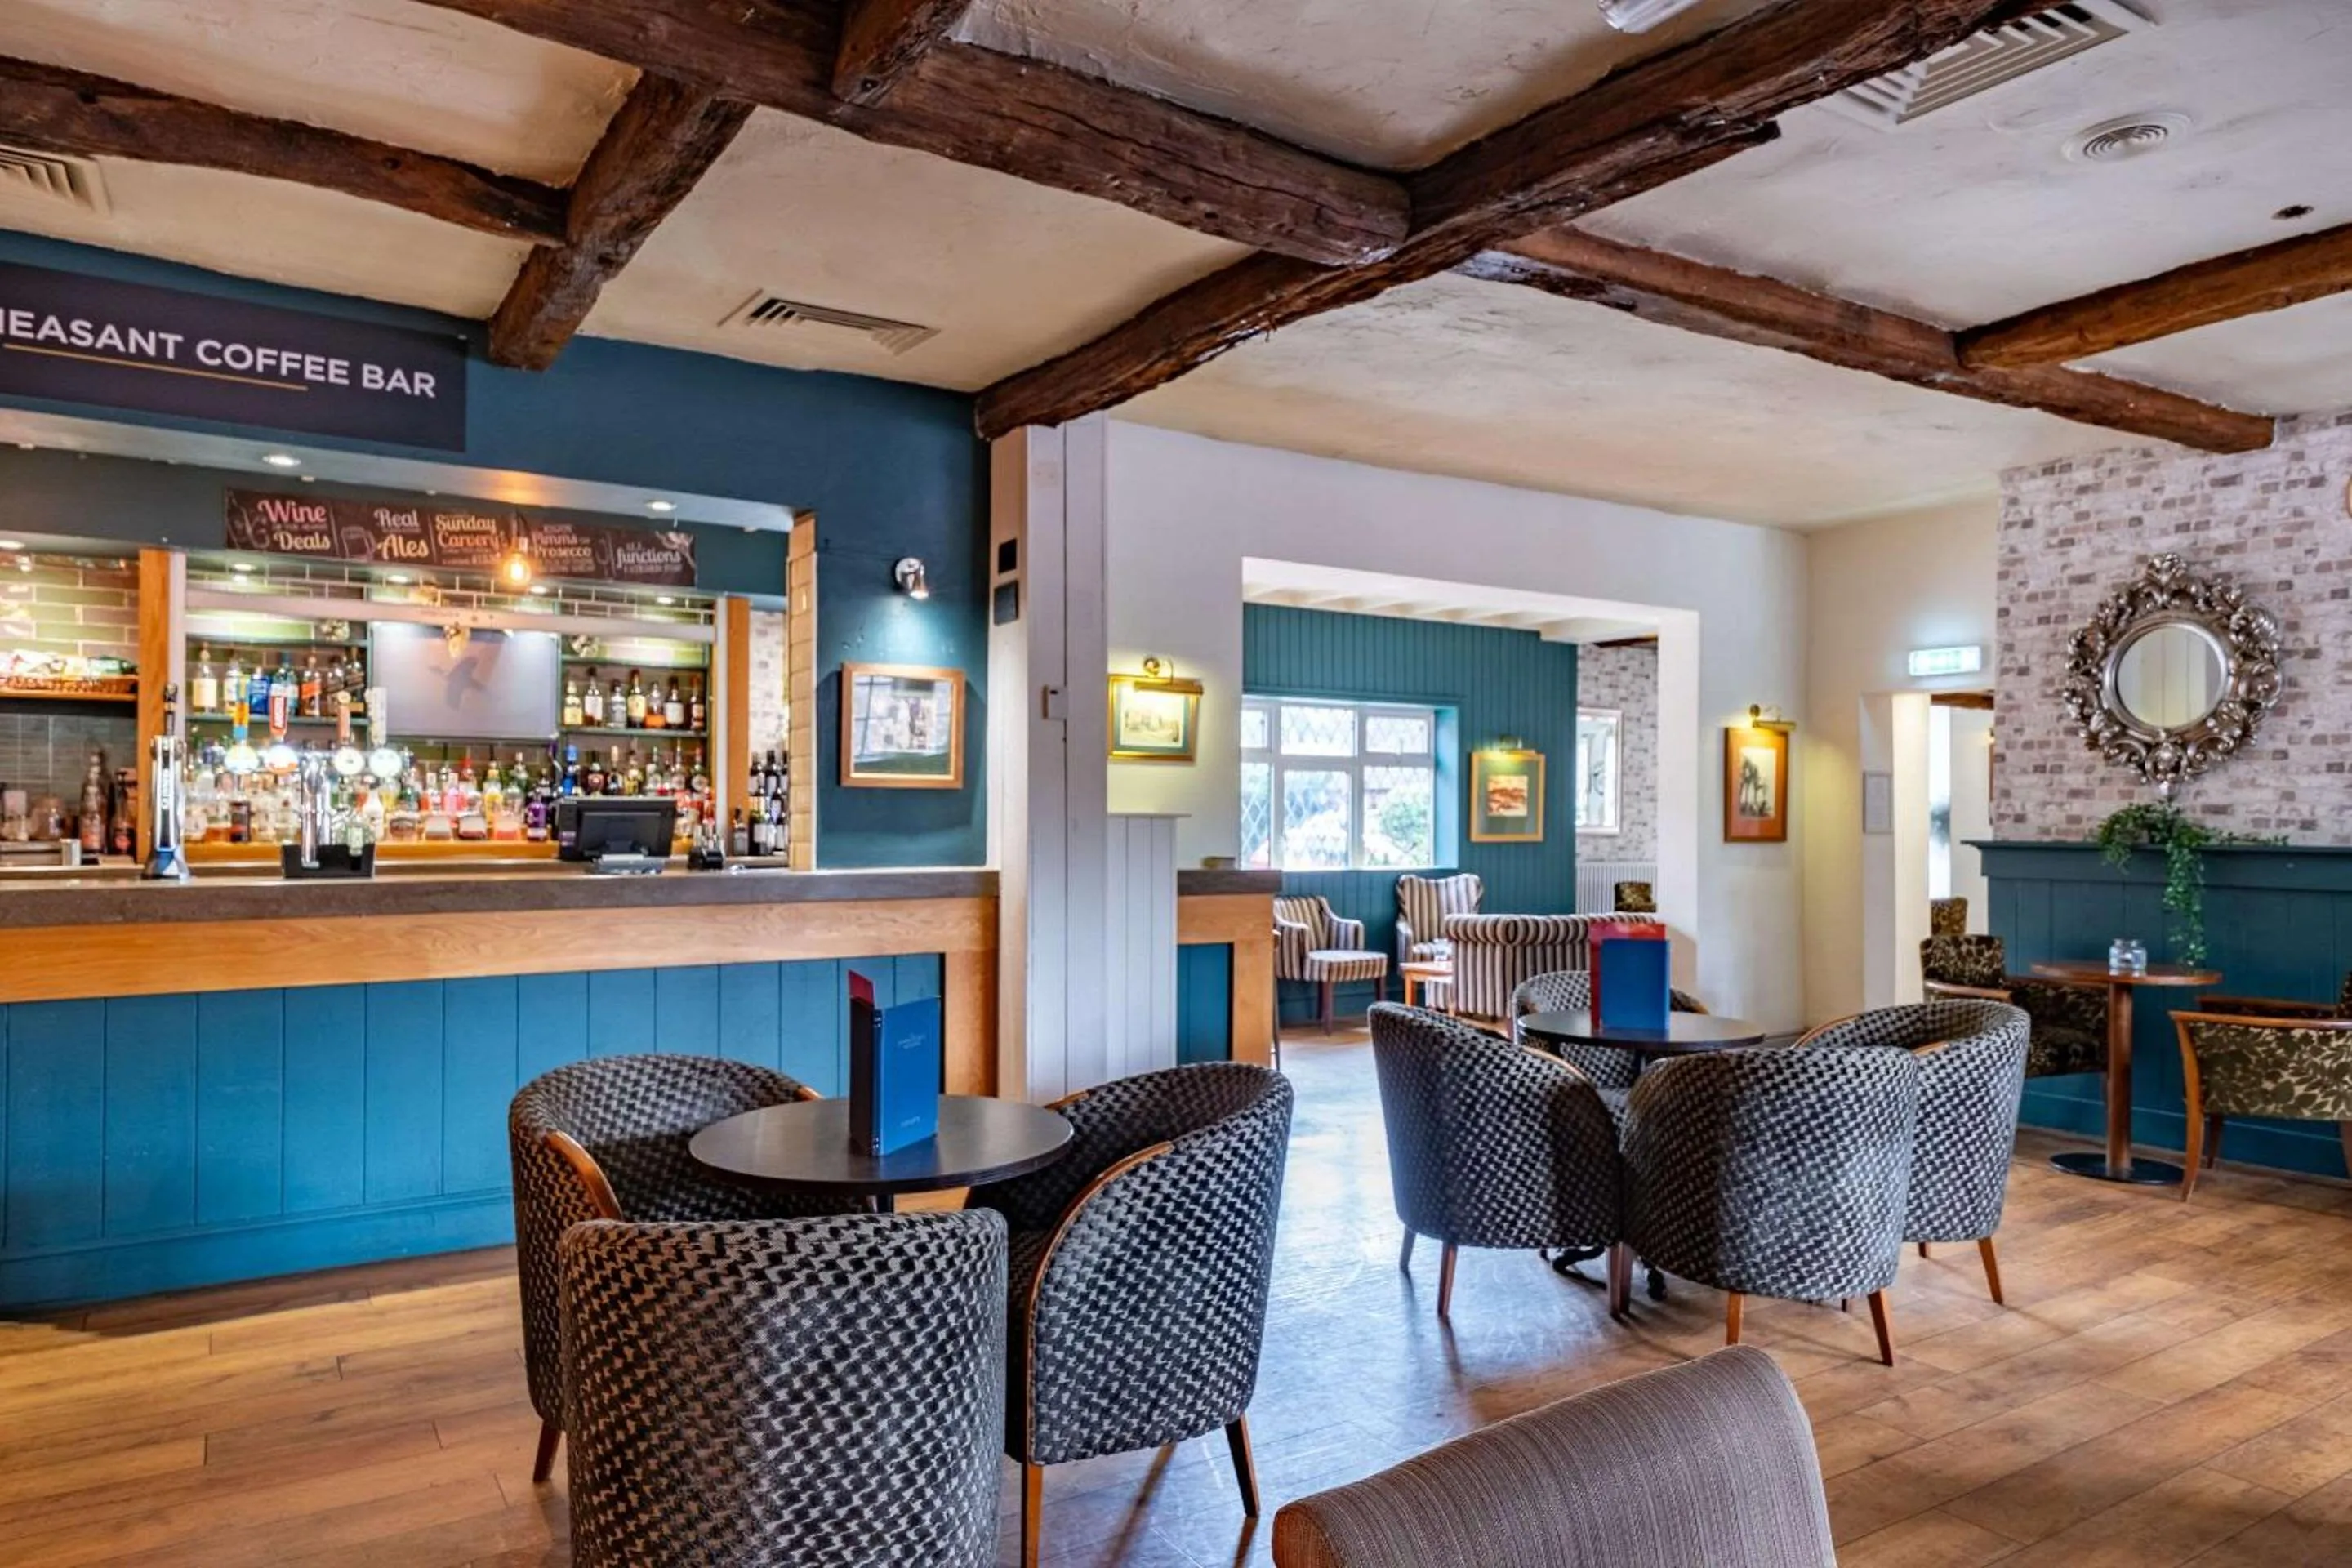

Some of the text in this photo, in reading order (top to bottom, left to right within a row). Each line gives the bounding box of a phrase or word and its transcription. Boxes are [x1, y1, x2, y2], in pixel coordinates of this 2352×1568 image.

[0, 307, 436, 399] EASANT COFFEE BAR
[257, 499, 327, 523] Wine
[373, 507, 421, 528] Real
[435, 514, 497, 535] Sunday
[274, 531, 331, 550] Deals
[376, 534, 430, 561] Ales
